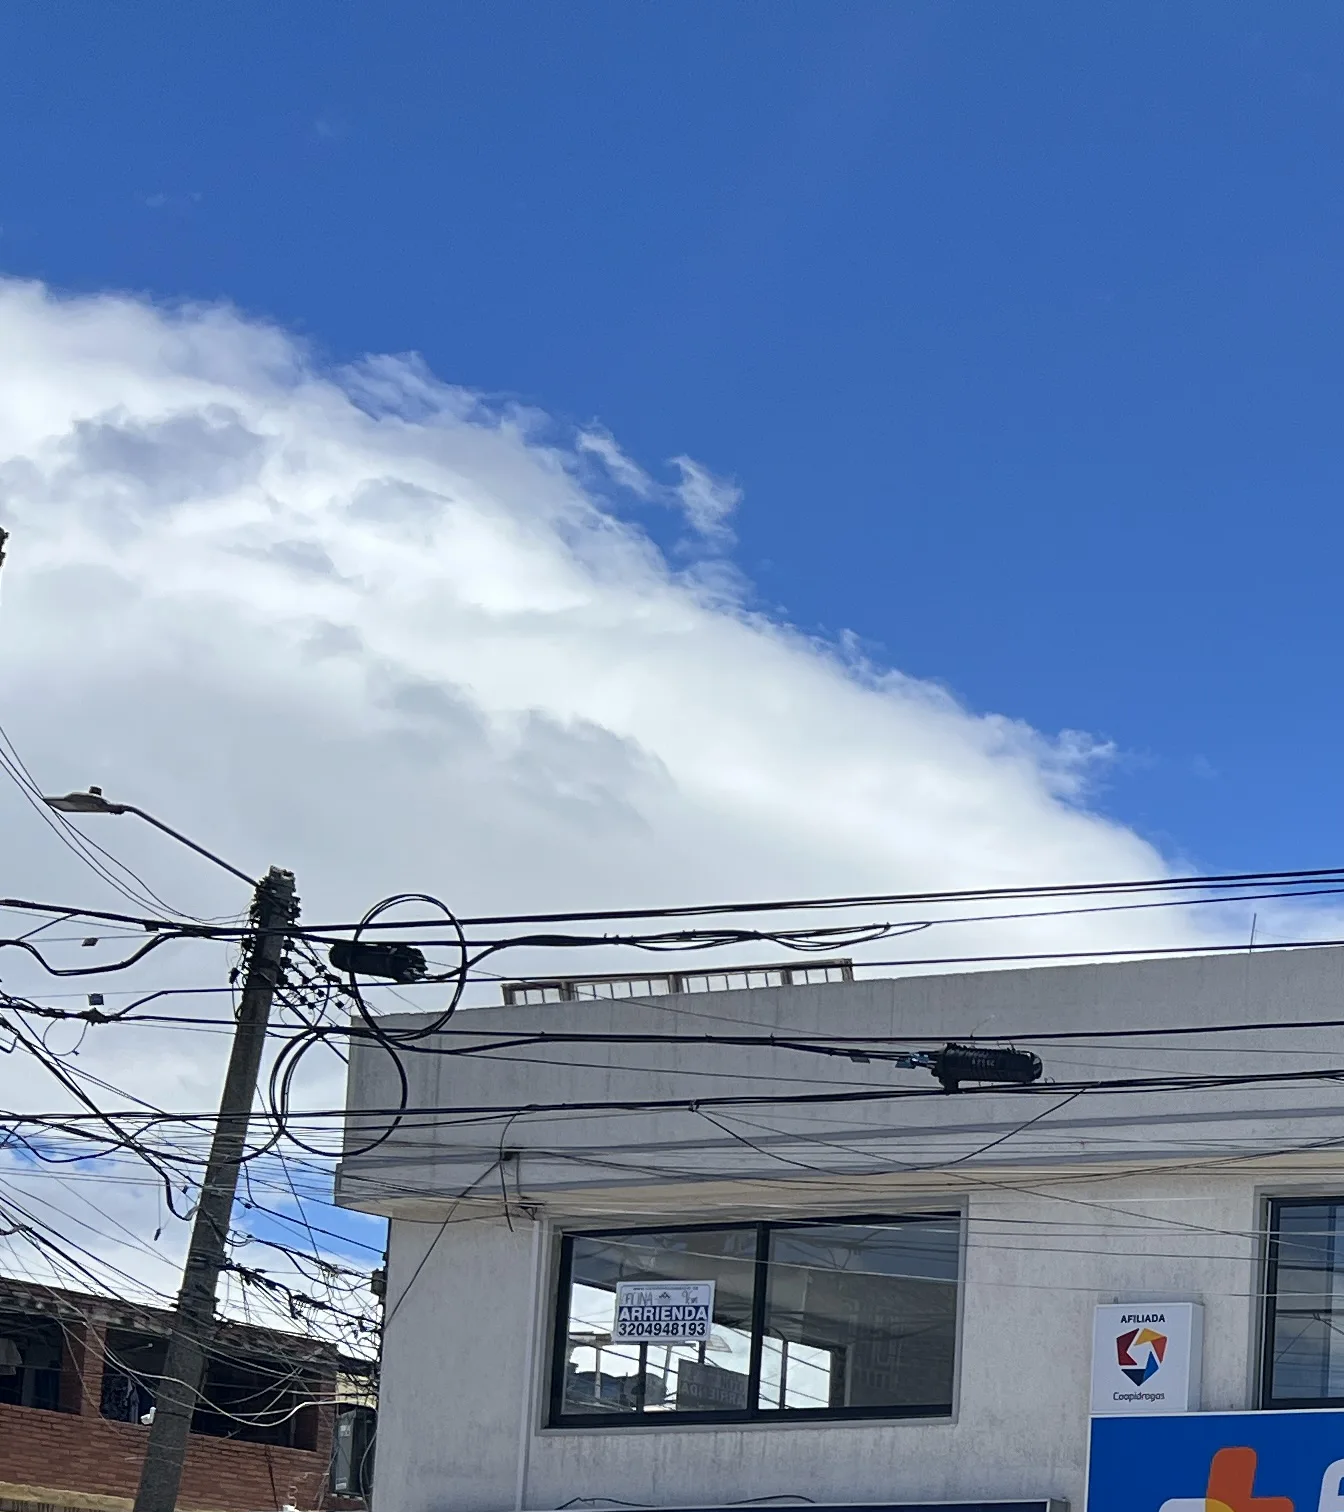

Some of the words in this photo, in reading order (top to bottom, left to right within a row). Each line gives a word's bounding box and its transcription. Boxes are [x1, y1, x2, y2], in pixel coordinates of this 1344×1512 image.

[619, 1306, 708, 1321] ARRIENDA
[1120, 1314, 1166, 1323] AFILIADA
[618, 1322, 706, 1336] 3204948193
[1113, 1391, 1165, 1402] Coopidrogas
